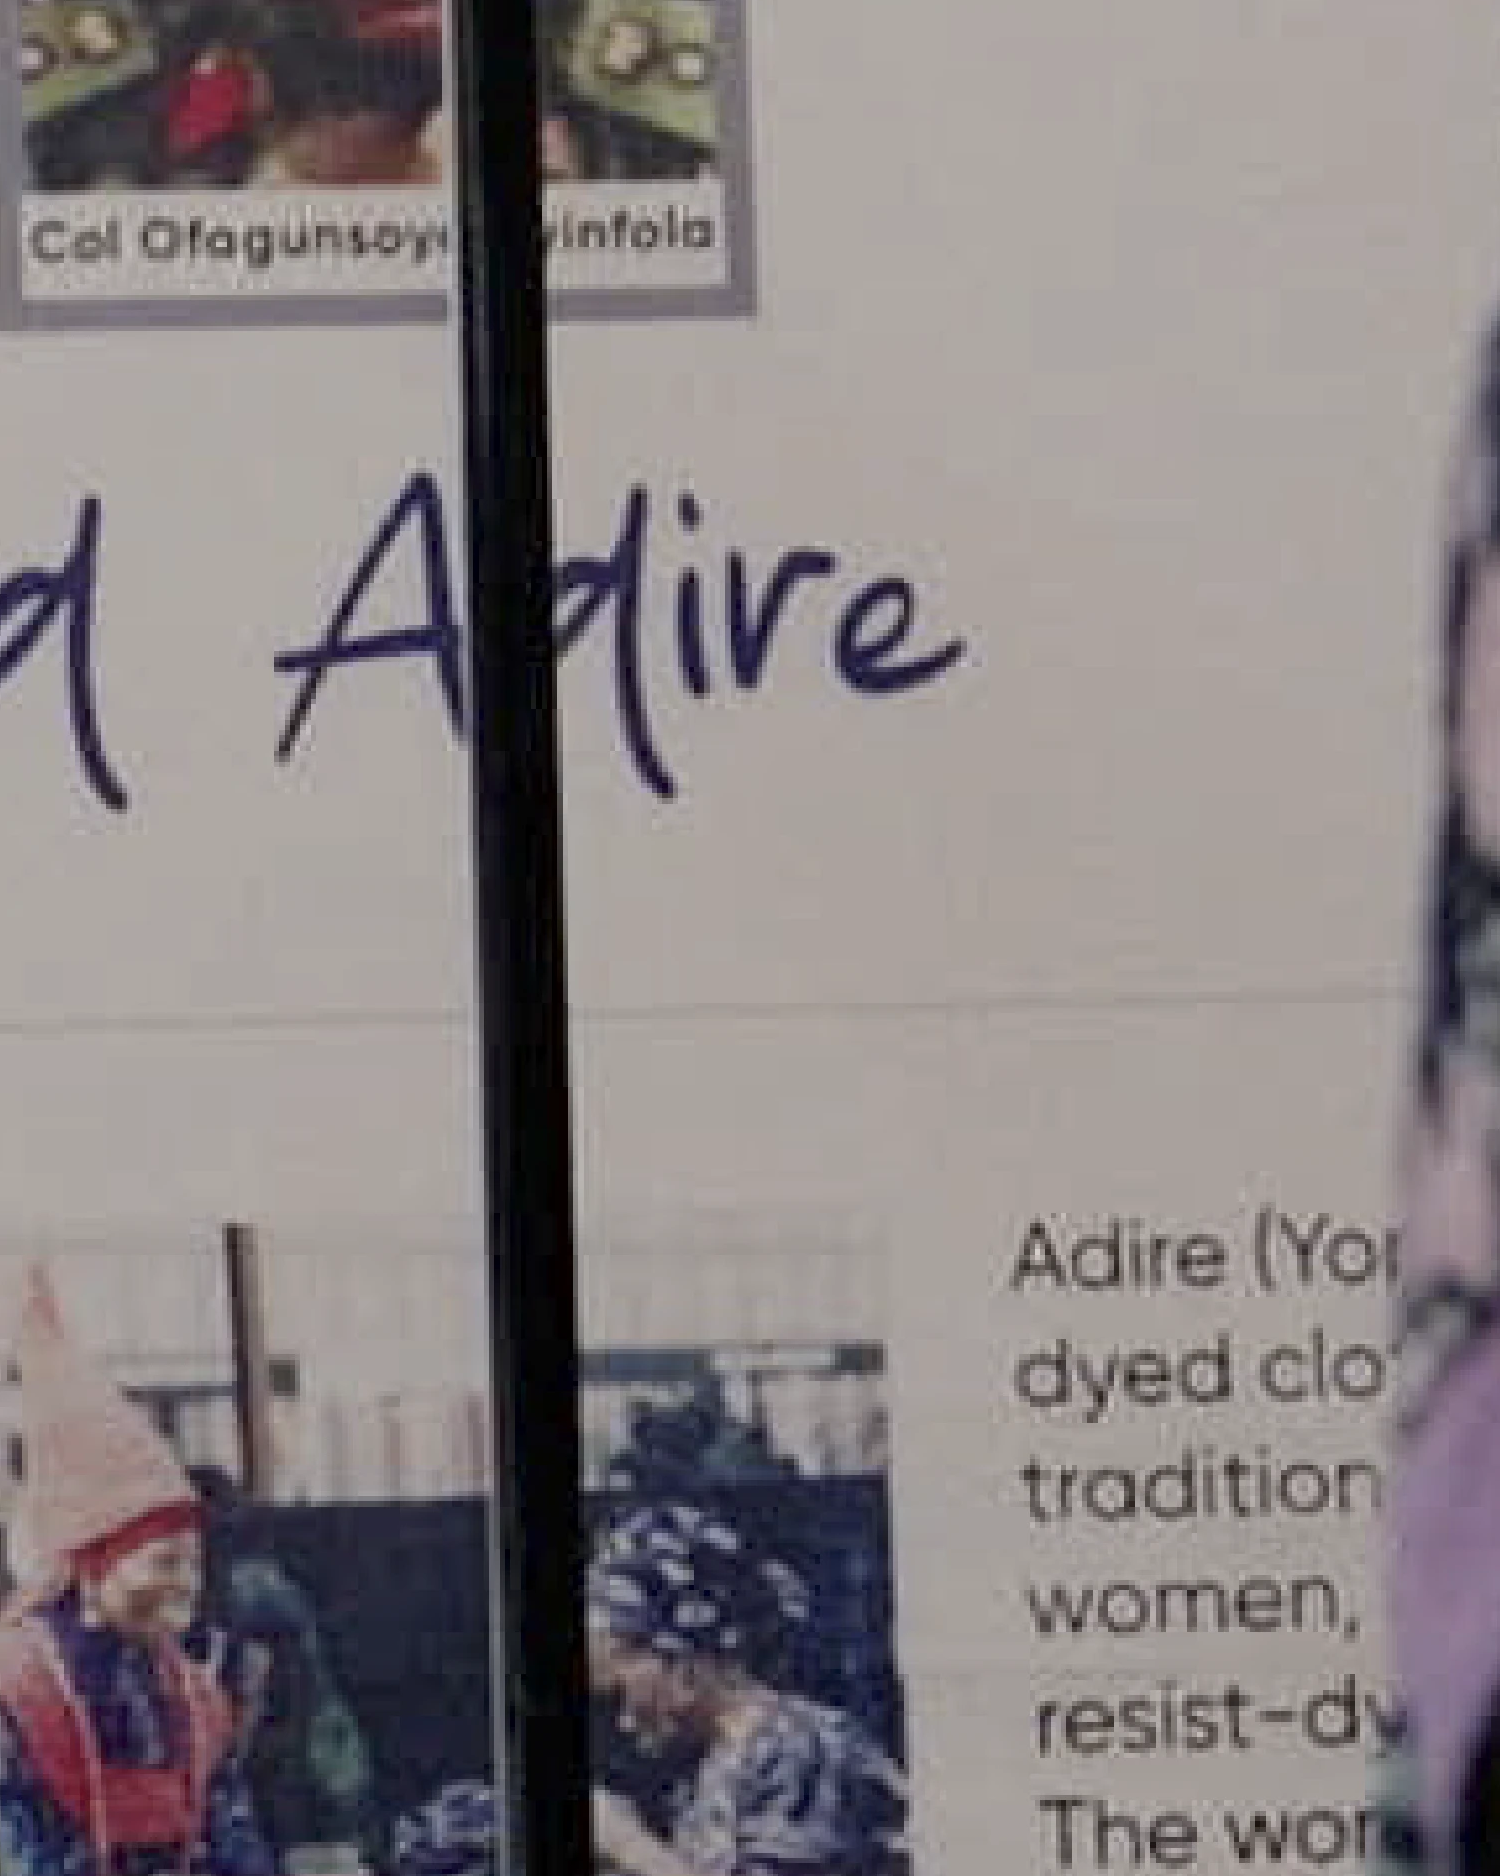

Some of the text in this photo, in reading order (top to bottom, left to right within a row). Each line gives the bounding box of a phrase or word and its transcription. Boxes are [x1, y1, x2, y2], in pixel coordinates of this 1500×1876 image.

[275, 471, 965, 801] Adire
[1010, 1221, 1226, 1289] Adire
[1015, 1328, 1399, 1423] dyed clo
[1027, 1577, 1360, 1639] women,
[1039, 1797, 1197, 1867] The
